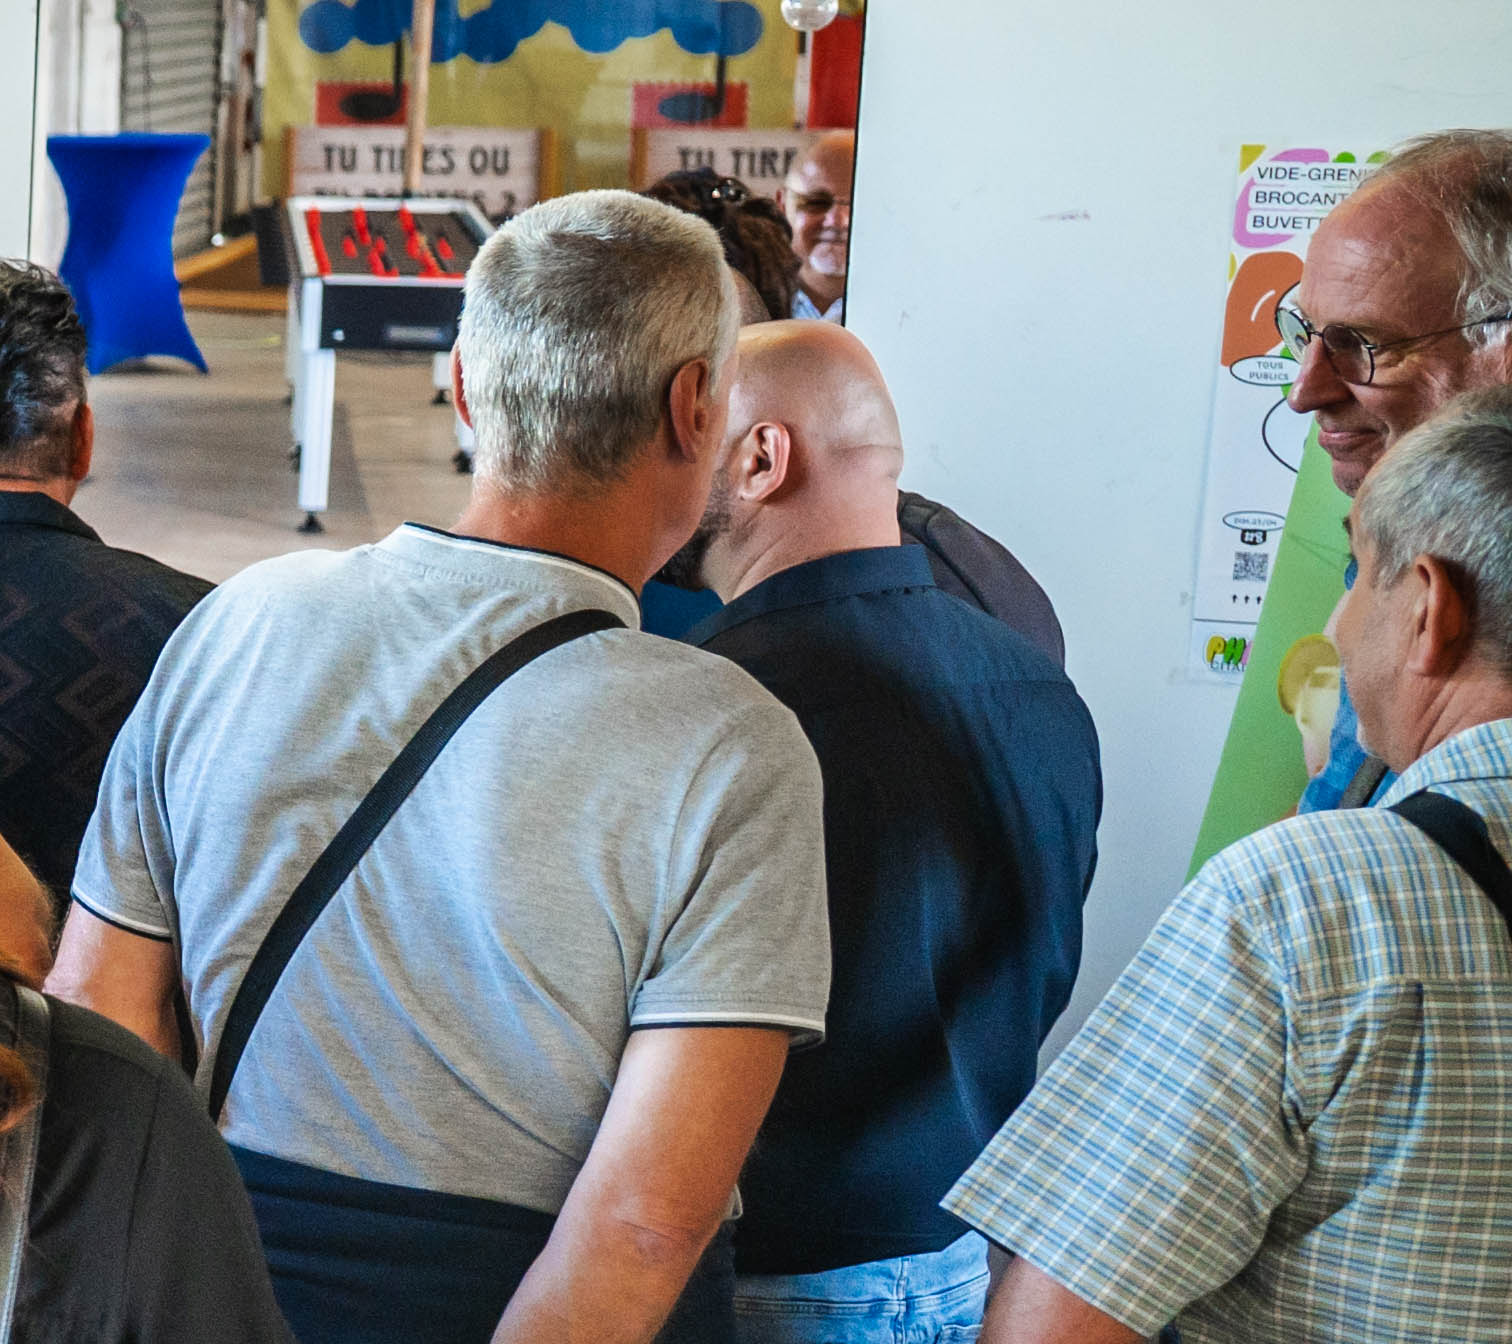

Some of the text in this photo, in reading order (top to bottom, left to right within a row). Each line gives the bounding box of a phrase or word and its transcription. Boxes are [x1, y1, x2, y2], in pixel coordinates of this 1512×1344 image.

[324, 143, 510, 176] TU TIES OU
[1257, 360, 1283, 370] TOUS
[1249, 372, 1289, 382] PUBLICS
